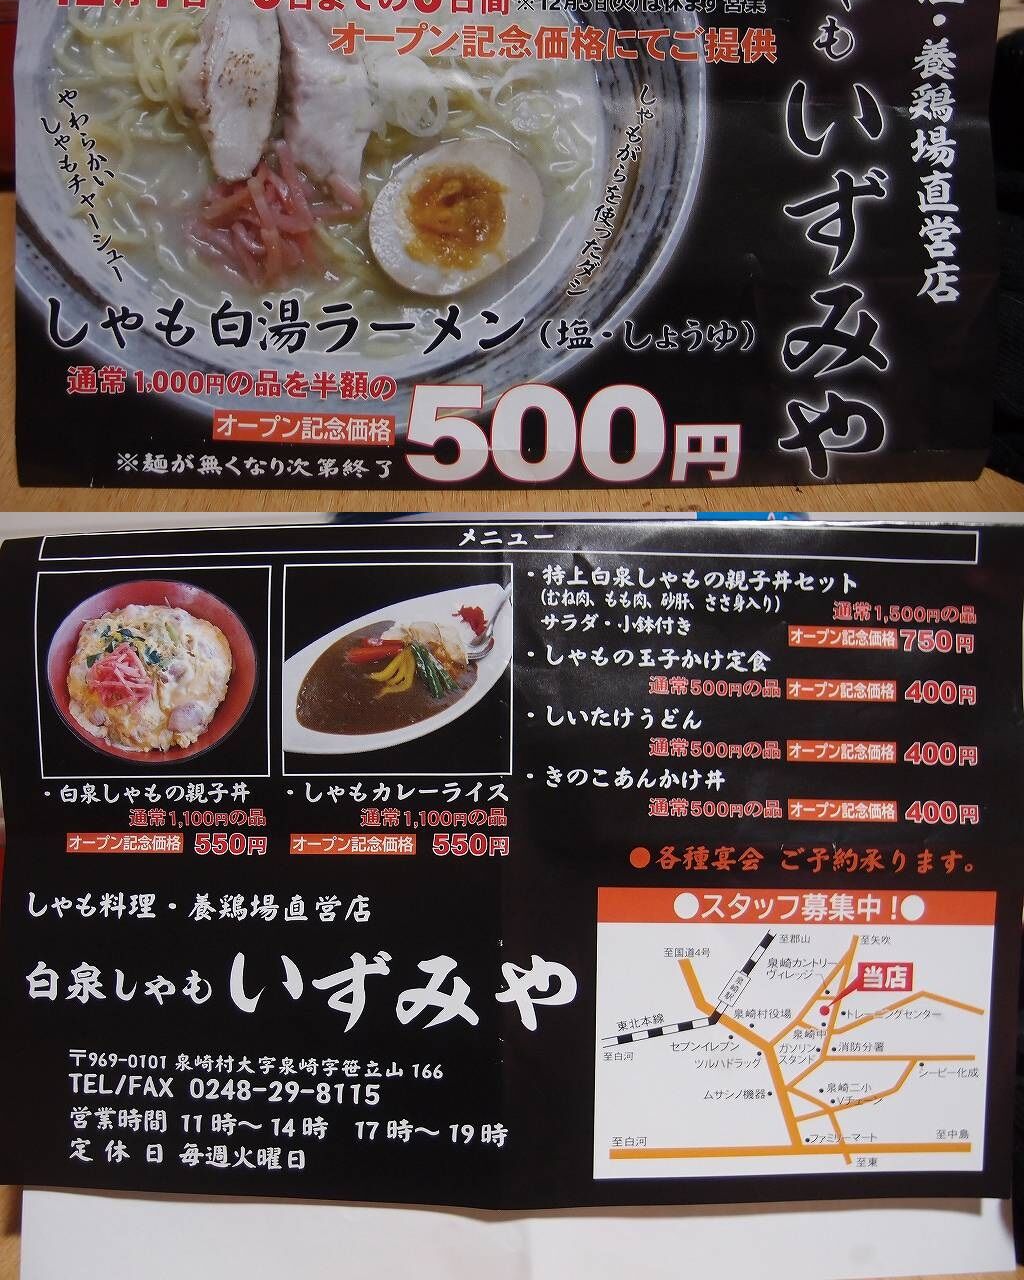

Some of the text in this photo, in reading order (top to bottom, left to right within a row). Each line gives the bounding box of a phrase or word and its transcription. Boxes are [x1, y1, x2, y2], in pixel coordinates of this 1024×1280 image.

[328, 21, 778, 64] オープン記念価格にてご提供
[57, 88, 115, 187] やわらかい
[40, 116, 125, 283] しゃもチャーシュー
[566, 83, 658, 297] しゃもがらを使ったダシ
[779, 79, 890, 479] いずみや
[46, 297, 525, 355] しゃも白湯ラーメン
[216, 413, 392, 443] オープン記念価格
[406, 382, 742, 484] 500円
[458, 527, 555, 547] メニュー
[540, 613, 692, 636] サラダ・小鉢付き
[790, 627, 975, 655] オープン記念価格 750円
[648, 675, 977, 705] 通常500円の品 オープン記念価格 400円
[648, 737, 978, 766] 通常500円の品 オープン記念価格 400円
[648, 797, 980, 824] 通常500円の品 オープン記念価格 400円
[68, 833, 268, 856] オープン記念価格 550円
[291, 833, 510, 856] オープン記念価格 550円
[27, 892, 372, 923] しゃも料理・養鶏場直営店
[663, 947, 711, 958] 至国道4号
[25, 950, 578, 1034] 白泉しゃも いずみや
[863, 966, 908, 990] 当店
[616, 1013, 665, 1032] 東北本線
[733, 1009, 792, 1019] 泉崎村役場
[603, 1051, 634, 1062] 至白河
[69, 1072, 380, 1106] TEL/FAX 0248-29-8115
[69, 1106, 168, 1133] 営業時間
[612, 1136, 648, 1147] 至白河
[179, 1142, 306, 1170] 毎週火曜日
